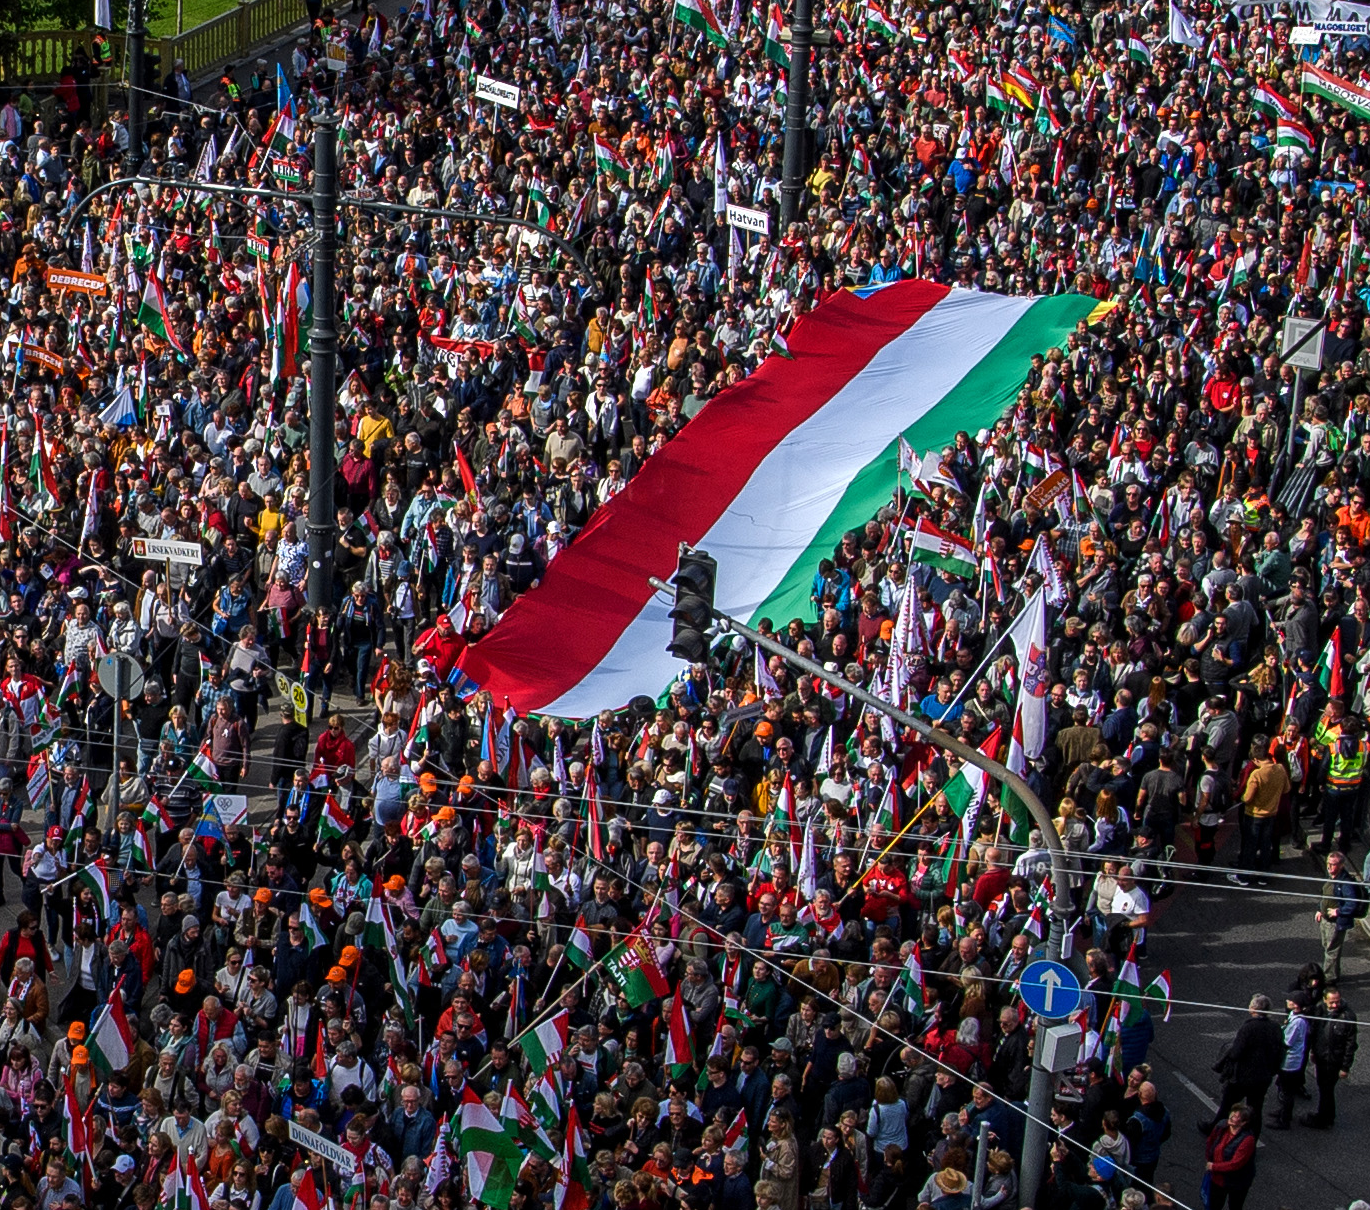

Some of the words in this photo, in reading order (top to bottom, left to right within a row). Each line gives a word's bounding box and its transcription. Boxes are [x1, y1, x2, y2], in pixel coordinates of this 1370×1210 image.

[730, 210, 765, 229] Hatvan
[50, 274, 105, 290] DEBRECEN
[12, 346, 62, 368] DBRECEN
[147, 543, 199, 559] ÉRSEKVADKERT
[279, 677, 289, 693] 30
[293, 684, 305, 704] 20
[291, 1126, 352, 1168] DUNAFÖLDVÁR
